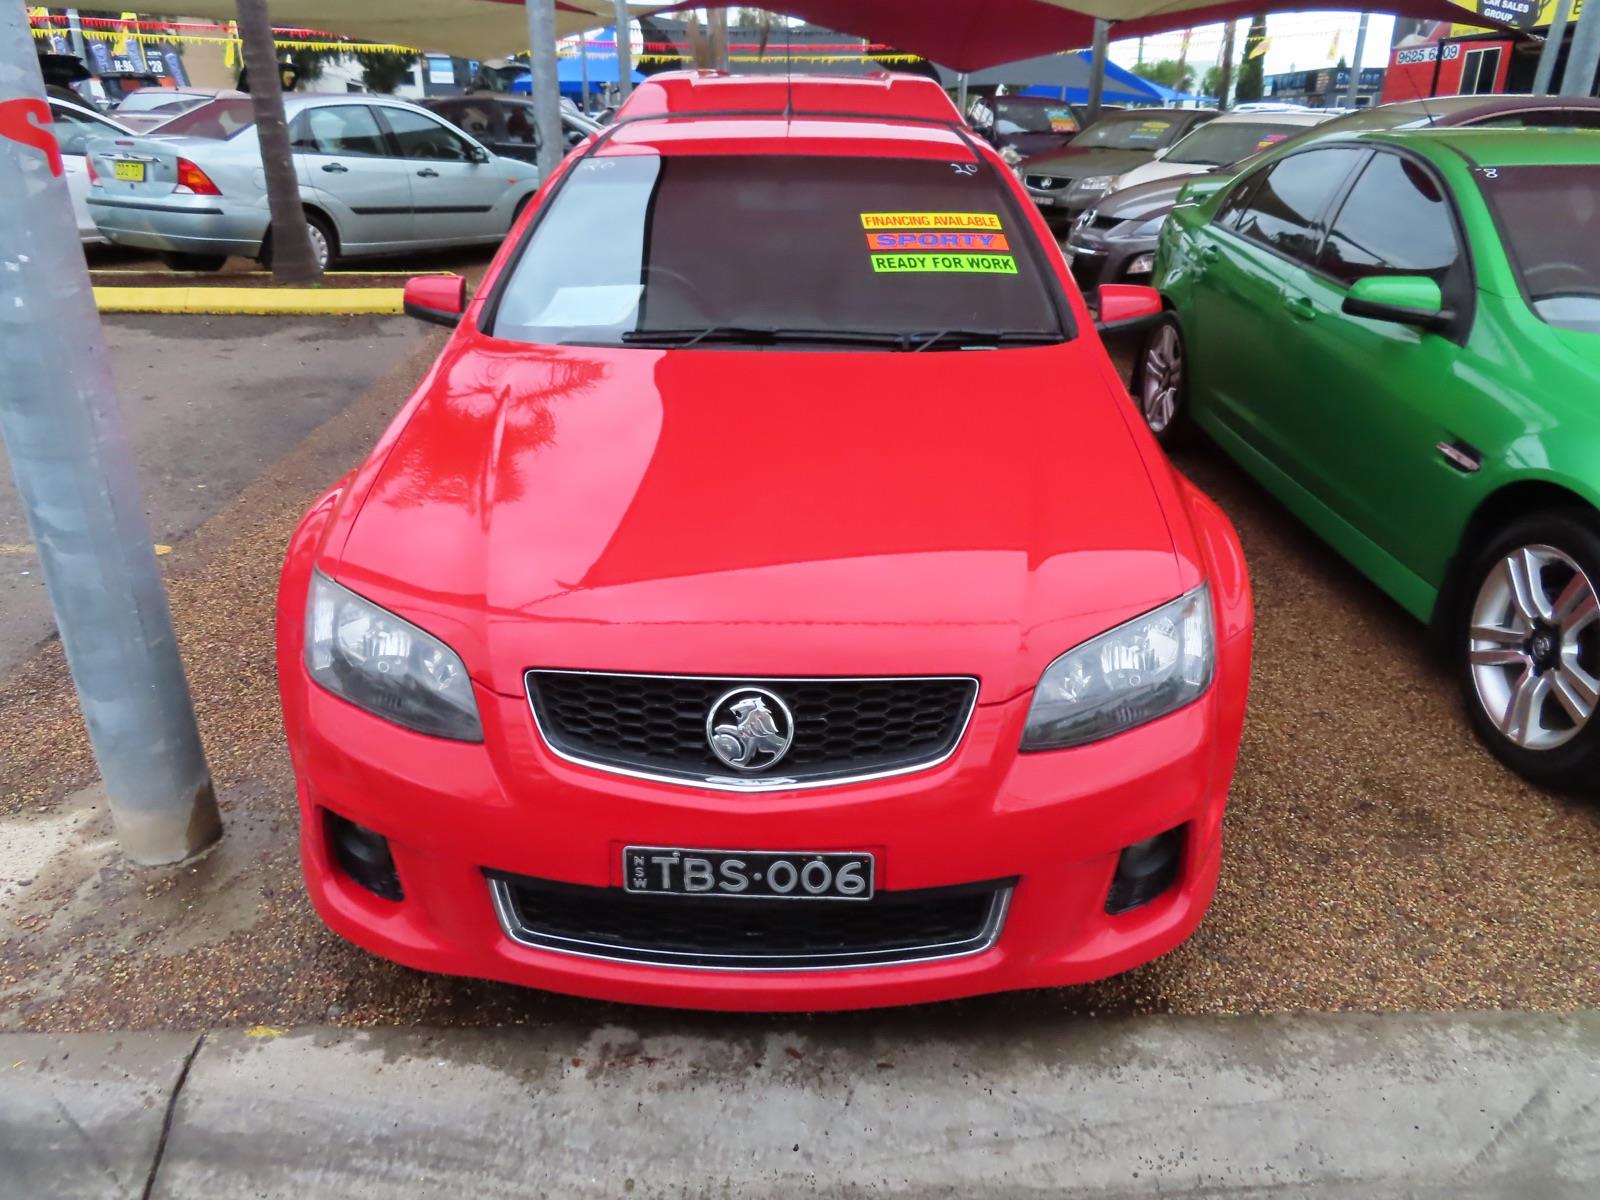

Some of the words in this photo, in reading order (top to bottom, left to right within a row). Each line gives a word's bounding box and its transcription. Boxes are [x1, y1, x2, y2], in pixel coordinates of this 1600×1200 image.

[1502, 1, 1529, 13] SALES
[1484, 8, 1513, 22] GROUP
[1398, 50, 1424, 63] 9625
[1429, 45, 1458, 60] 609
[865, 215, 930, 227] FINANCING
[934, 215, 997, 227] AVAILABLE
[877, 234, 995, 247] SPORTY
[876, 257, 926, 269] READY
[933, 258, 964, 269] FOR
[967, 258, 1013, 270] WORK
[633, 855, 648, 889] NSW
